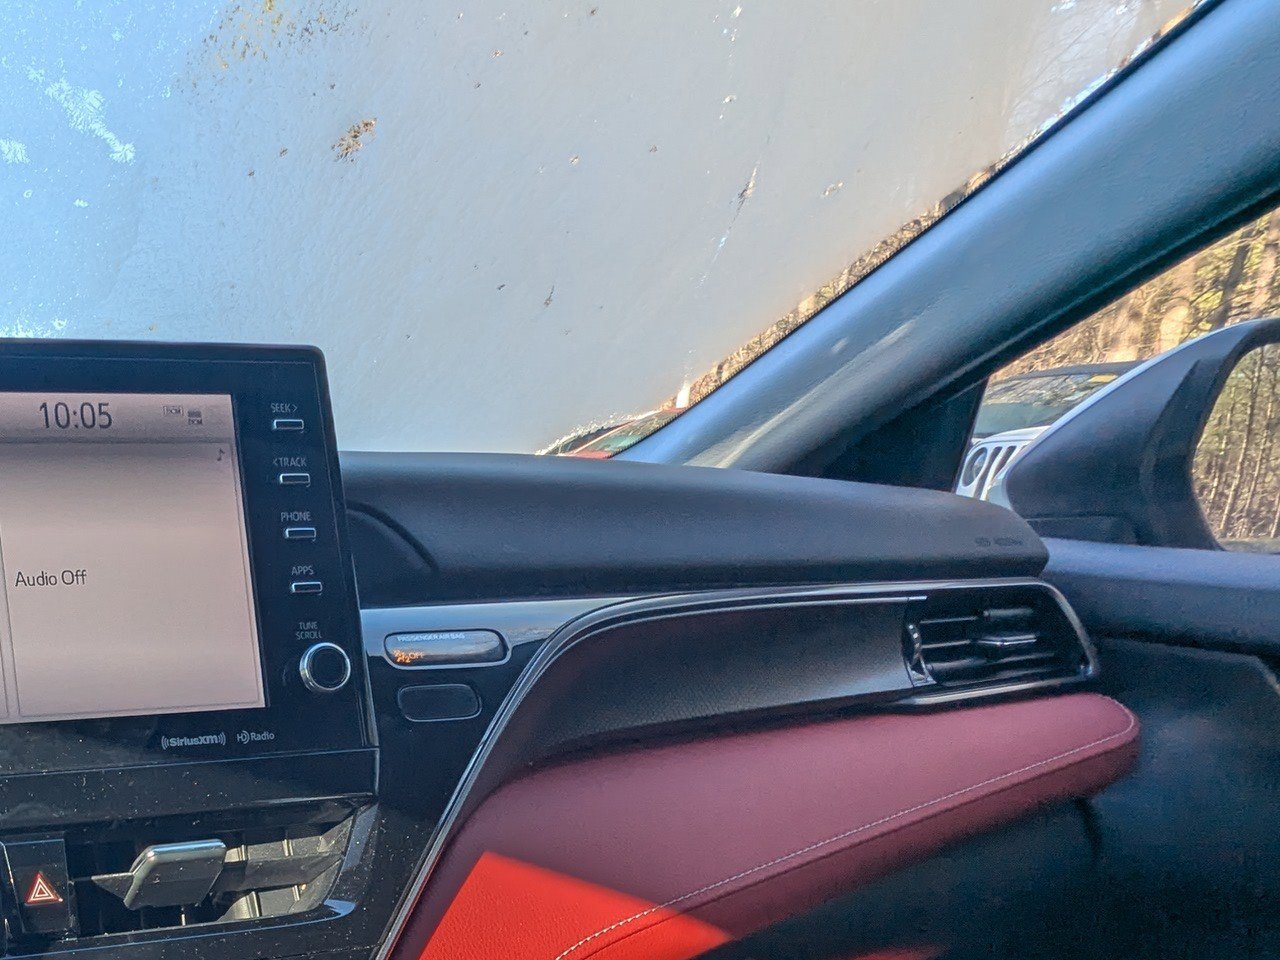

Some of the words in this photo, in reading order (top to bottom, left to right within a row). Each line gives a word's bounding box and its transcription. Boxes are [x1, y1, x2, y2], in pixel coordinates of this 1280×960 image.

[39, 401, 113, 430] 10:05
[281, 512, 311, 521] PHONE
[291, 565, 314, 575] APPS
[14, 570, 58, 588] Audio
[61, 569, 88, 586] Off
[298, 621, 318, 630] TUNE
[250, 731, 275, 741] Radio
